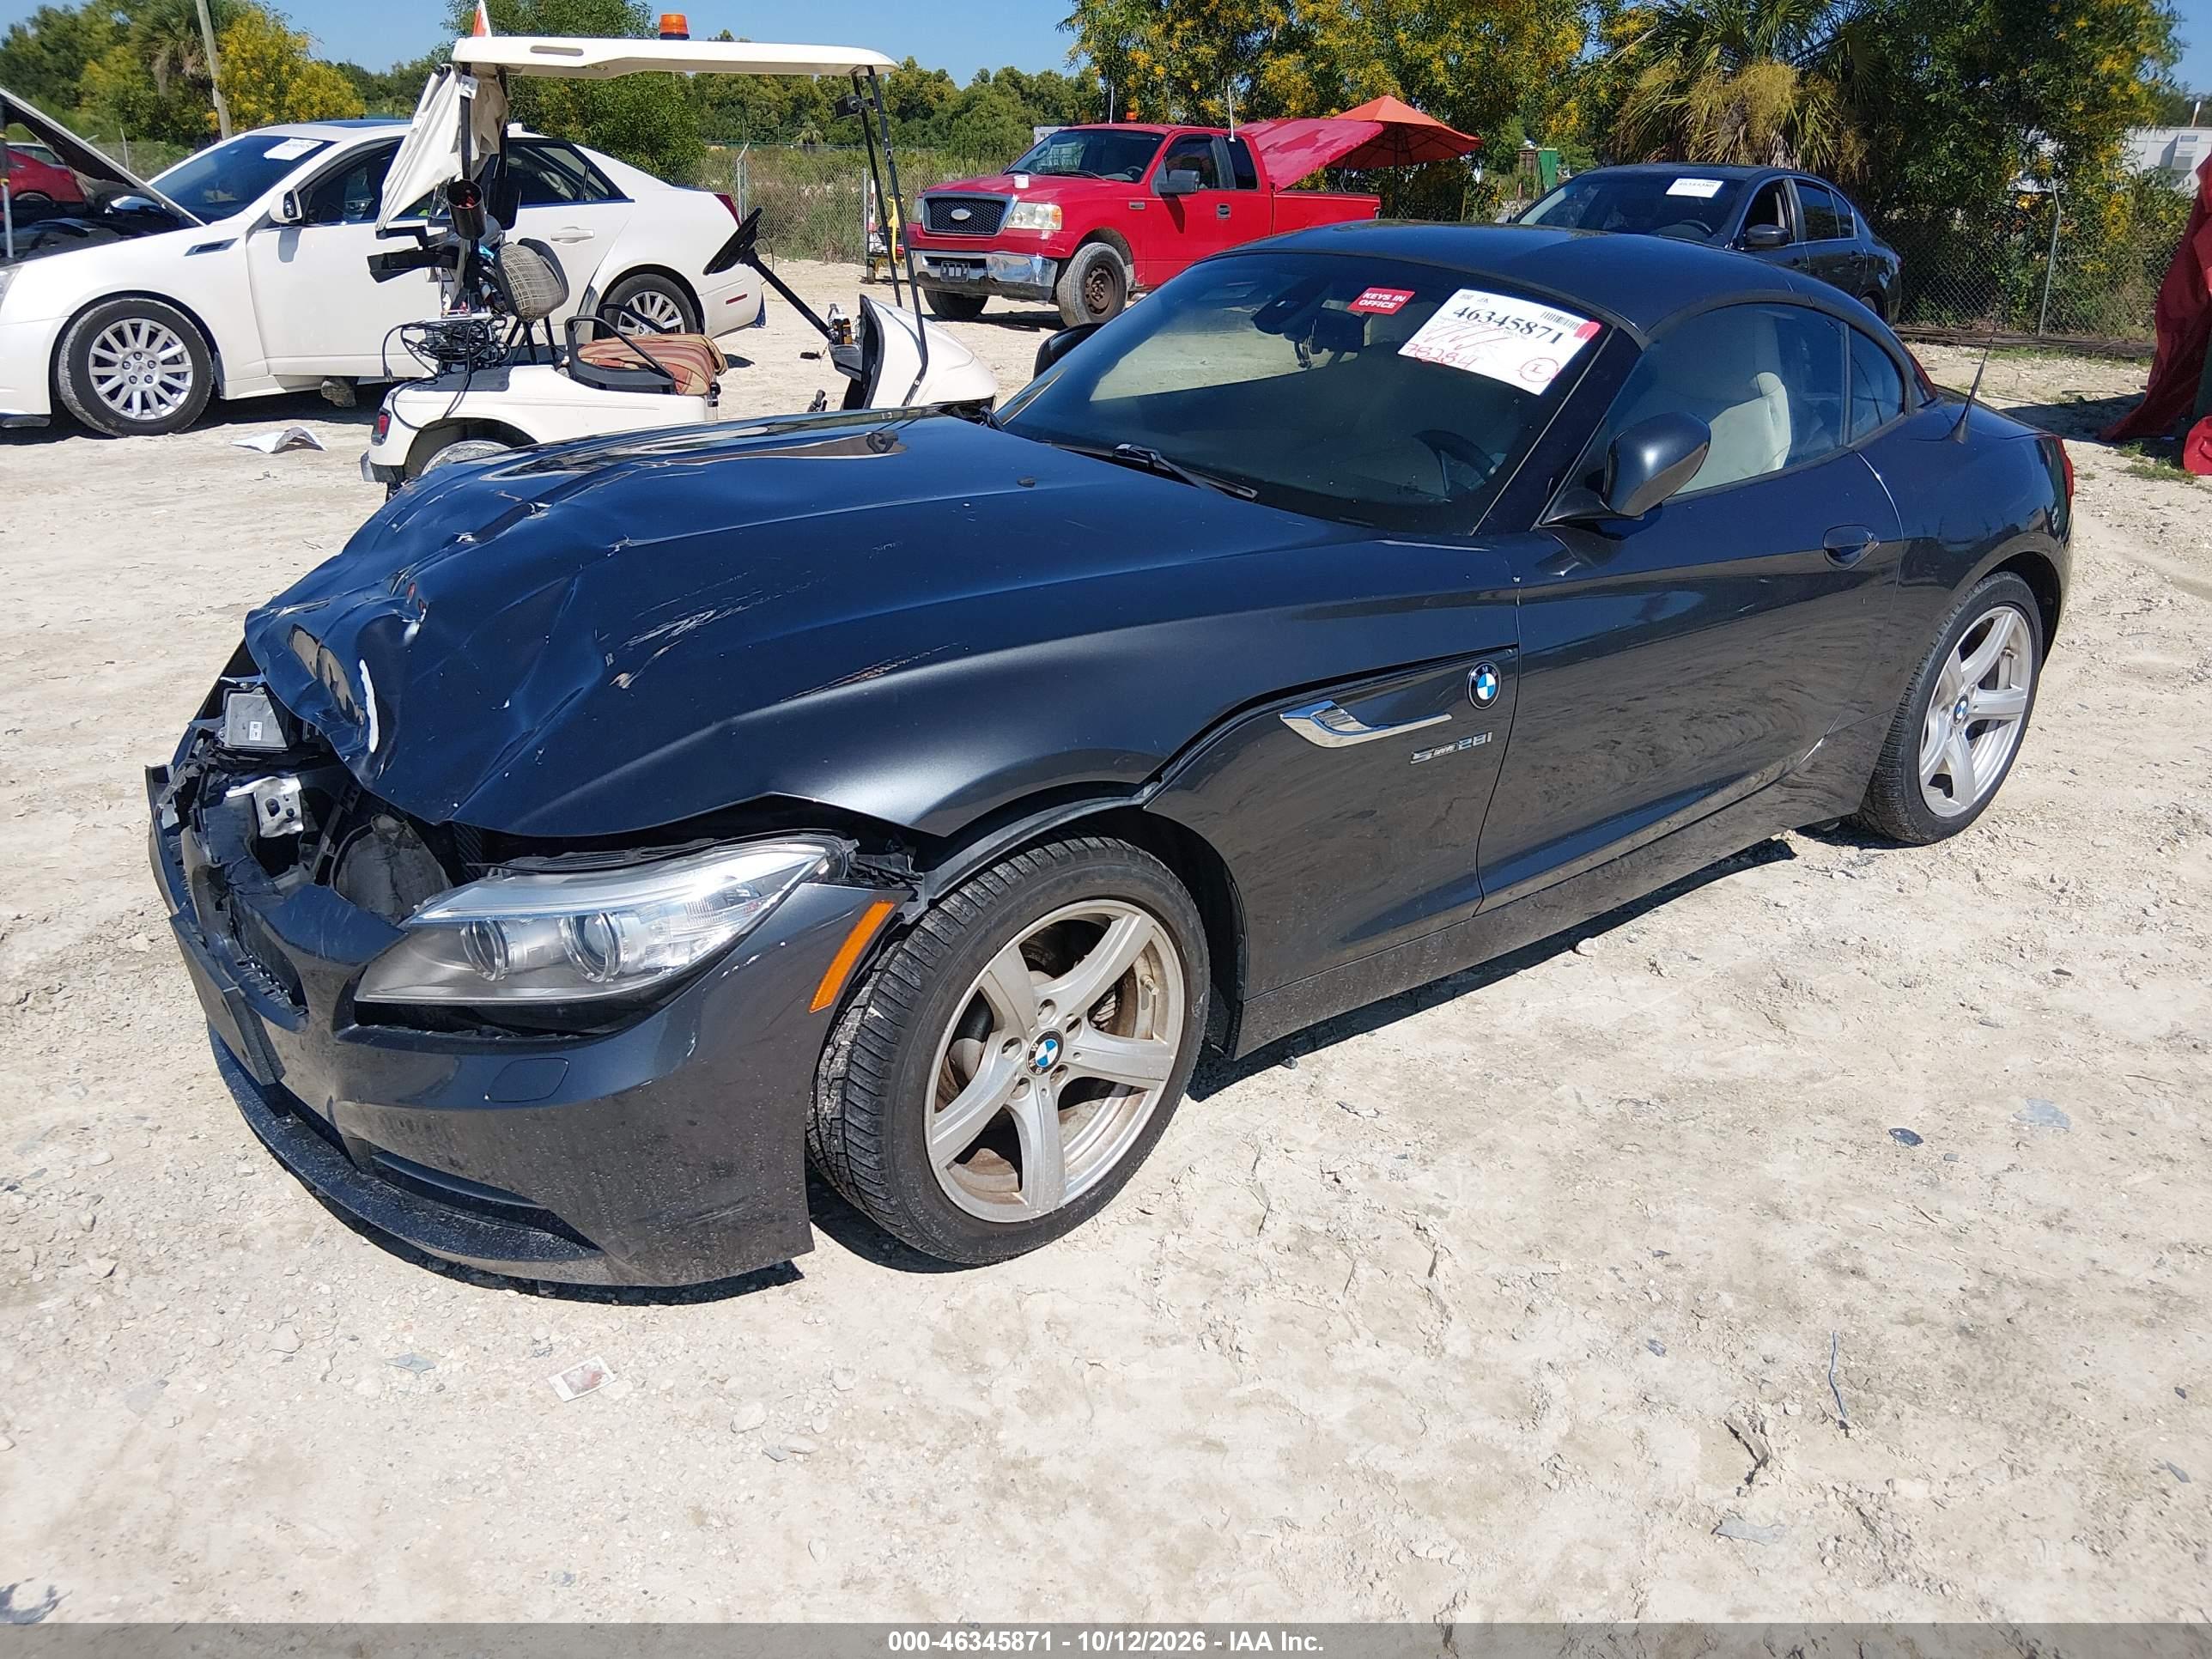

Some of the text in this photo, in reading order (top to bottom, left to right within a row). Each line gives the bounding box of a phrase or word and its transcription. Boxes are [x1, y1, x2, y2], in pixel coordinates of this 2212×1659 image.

[1362, 292, 1393, 301] KEYS
[1358, 300, 1397, 309] OFFICE
[1453, 306, 1565, 344] 46345871
